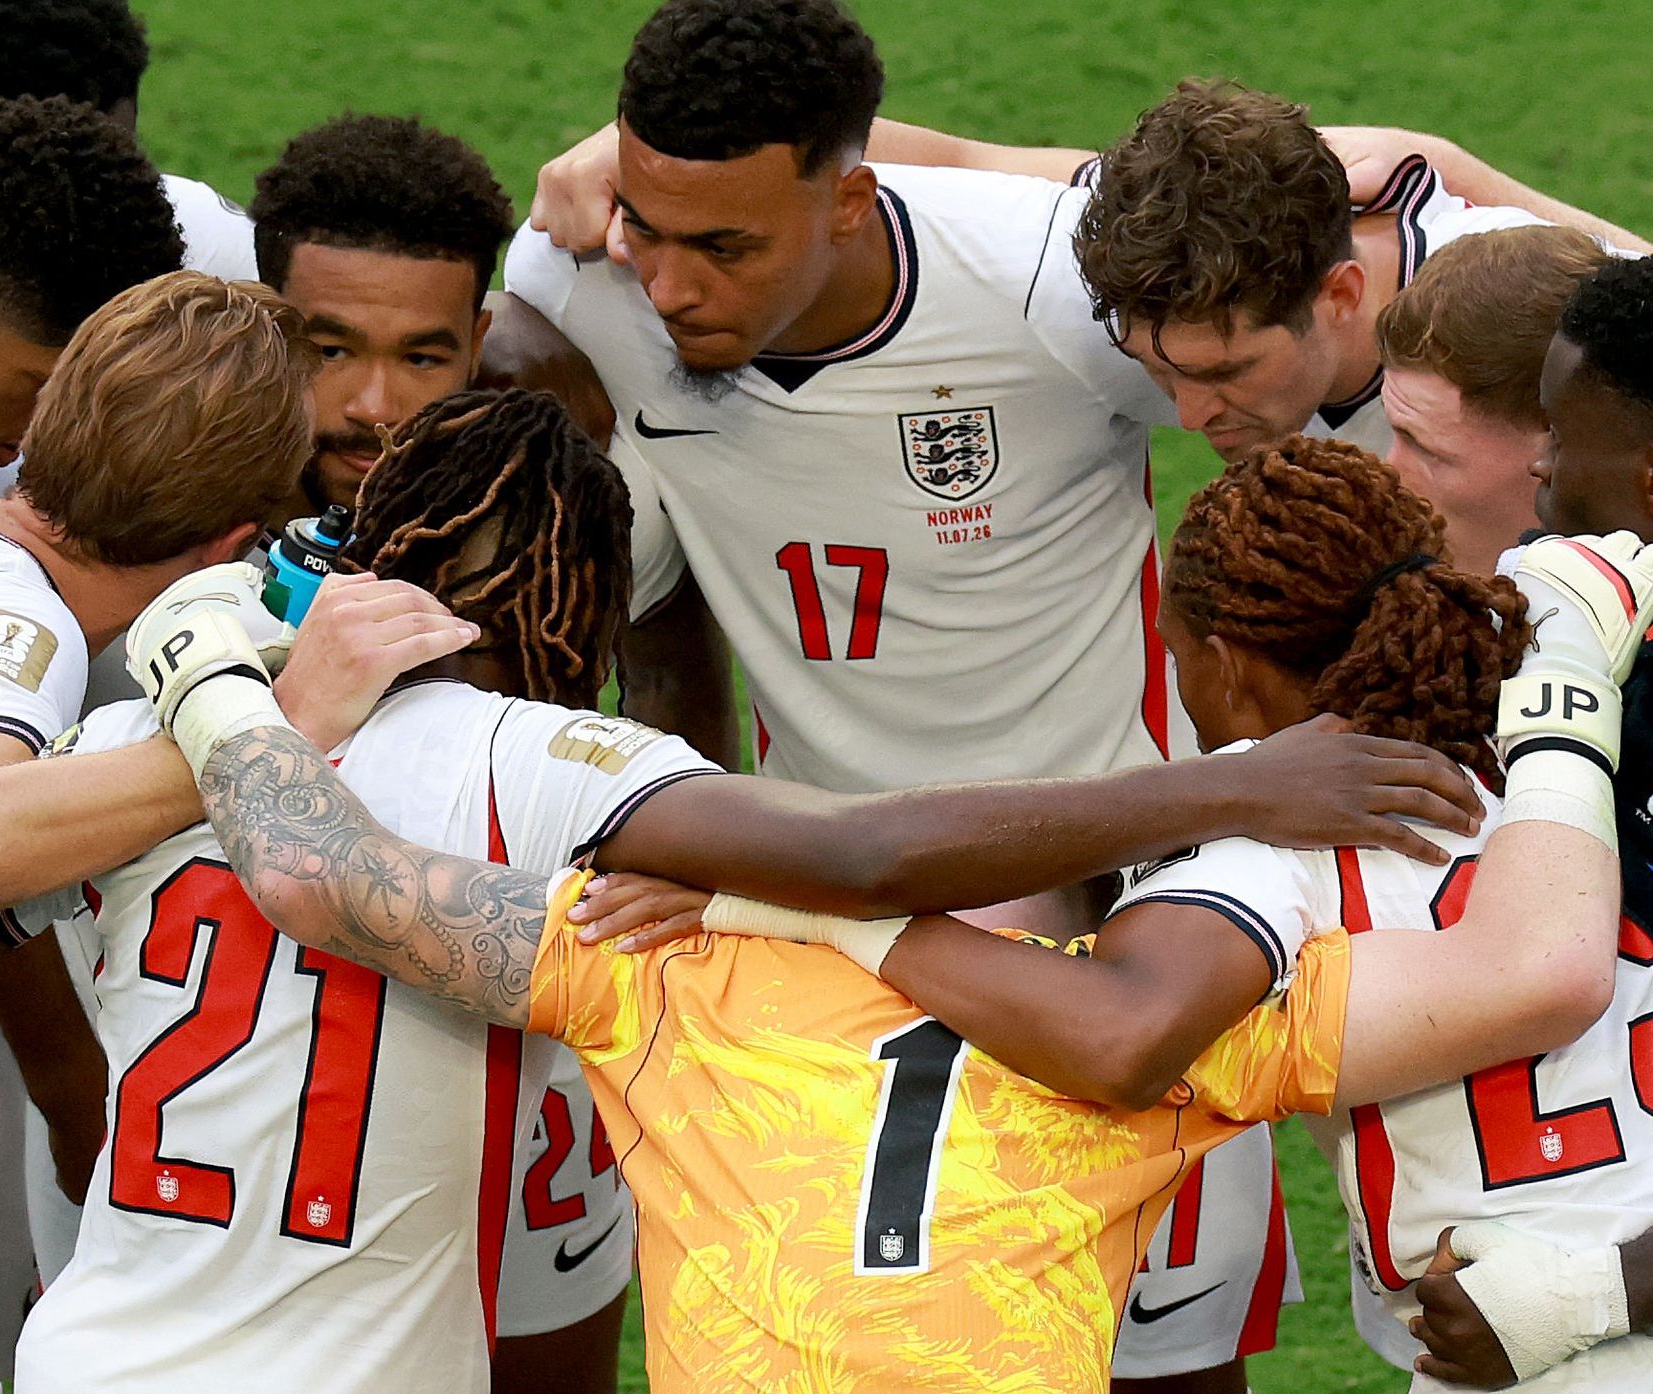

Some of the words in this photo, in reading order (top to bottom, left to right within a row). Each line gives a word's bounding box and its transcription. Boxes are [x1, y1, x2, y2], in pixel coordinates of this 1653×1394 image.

[926, 504, 993, 527] NORWAY
[936, 525, 992, 545] 11.07.26
[775, 541, 890, 661] 17
[148, 629, 195, 705] JP
[1519, 682, 1600, 720] JP
[108, 856, 389, 1249] 21
[853, 1014, 972, 1277] 1
